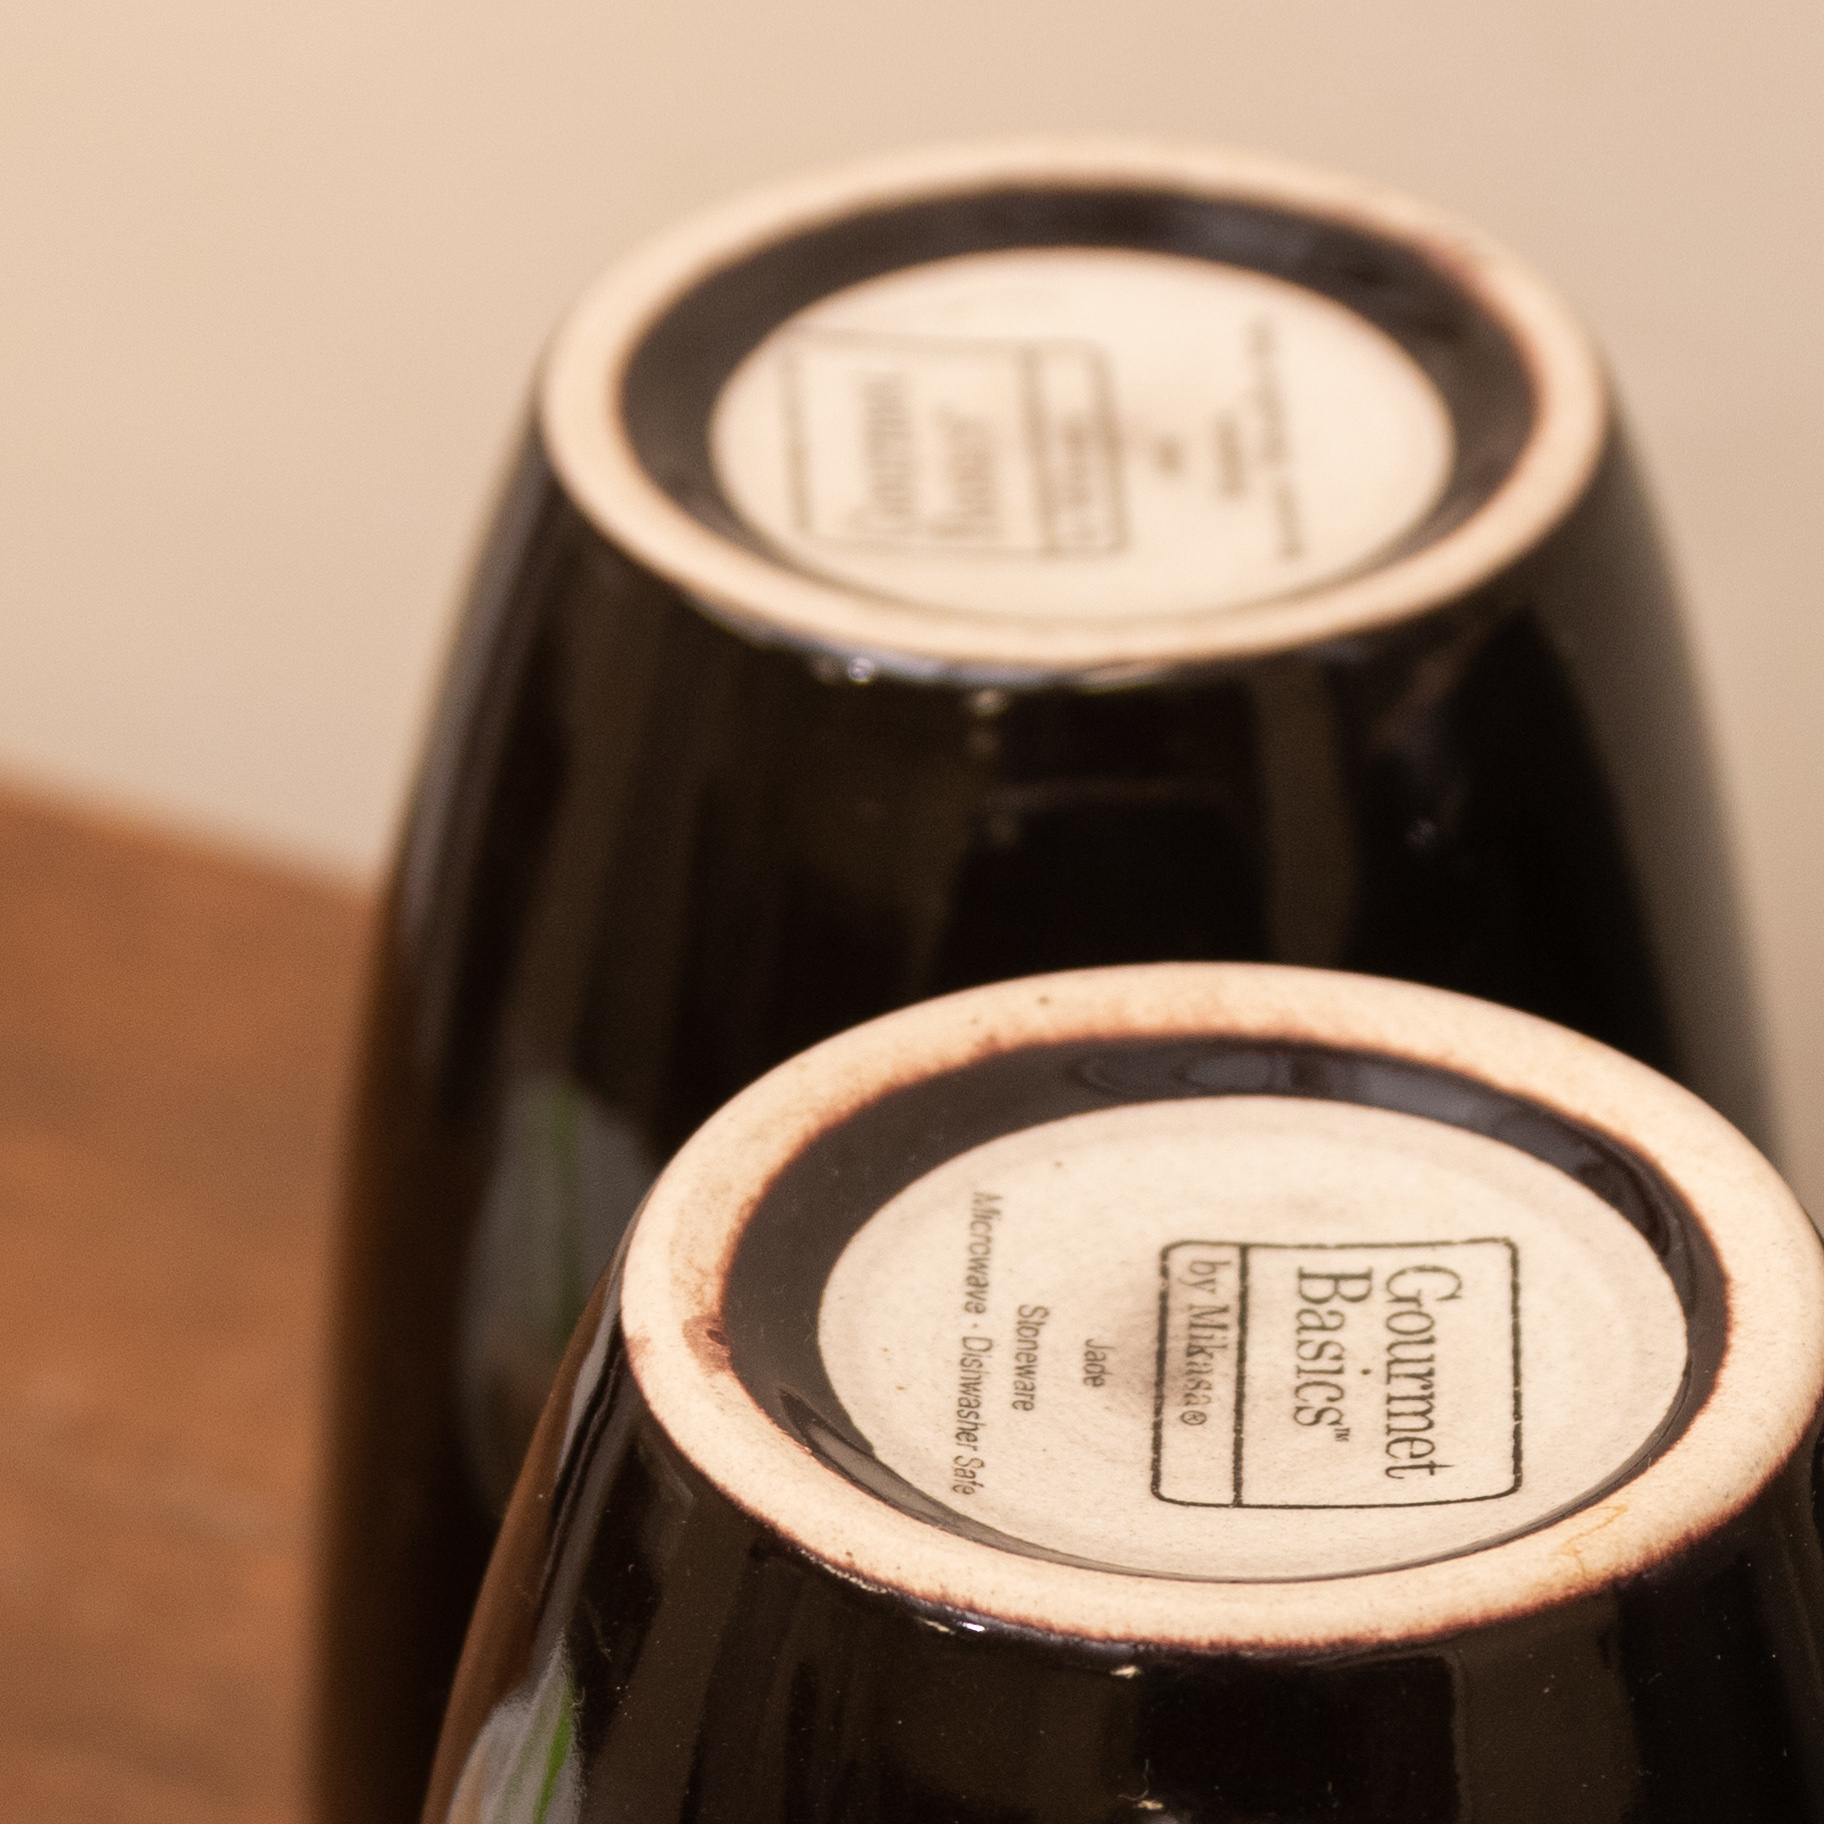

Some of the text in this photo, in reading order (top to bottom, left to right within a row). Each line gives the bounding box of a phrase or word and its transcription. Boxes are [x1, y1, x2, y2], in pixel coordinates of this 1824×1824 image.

[1180, 1259, 1232, 1295] by
[951, 1191, 1003, 1497] Microwave Dishwasher Safe
[1012, 1303, 1049, 1412] Stoneware
[1082, 1339, 1116, 1388] Jade
[1384, 1264, 1464, 1480] Gourmet
